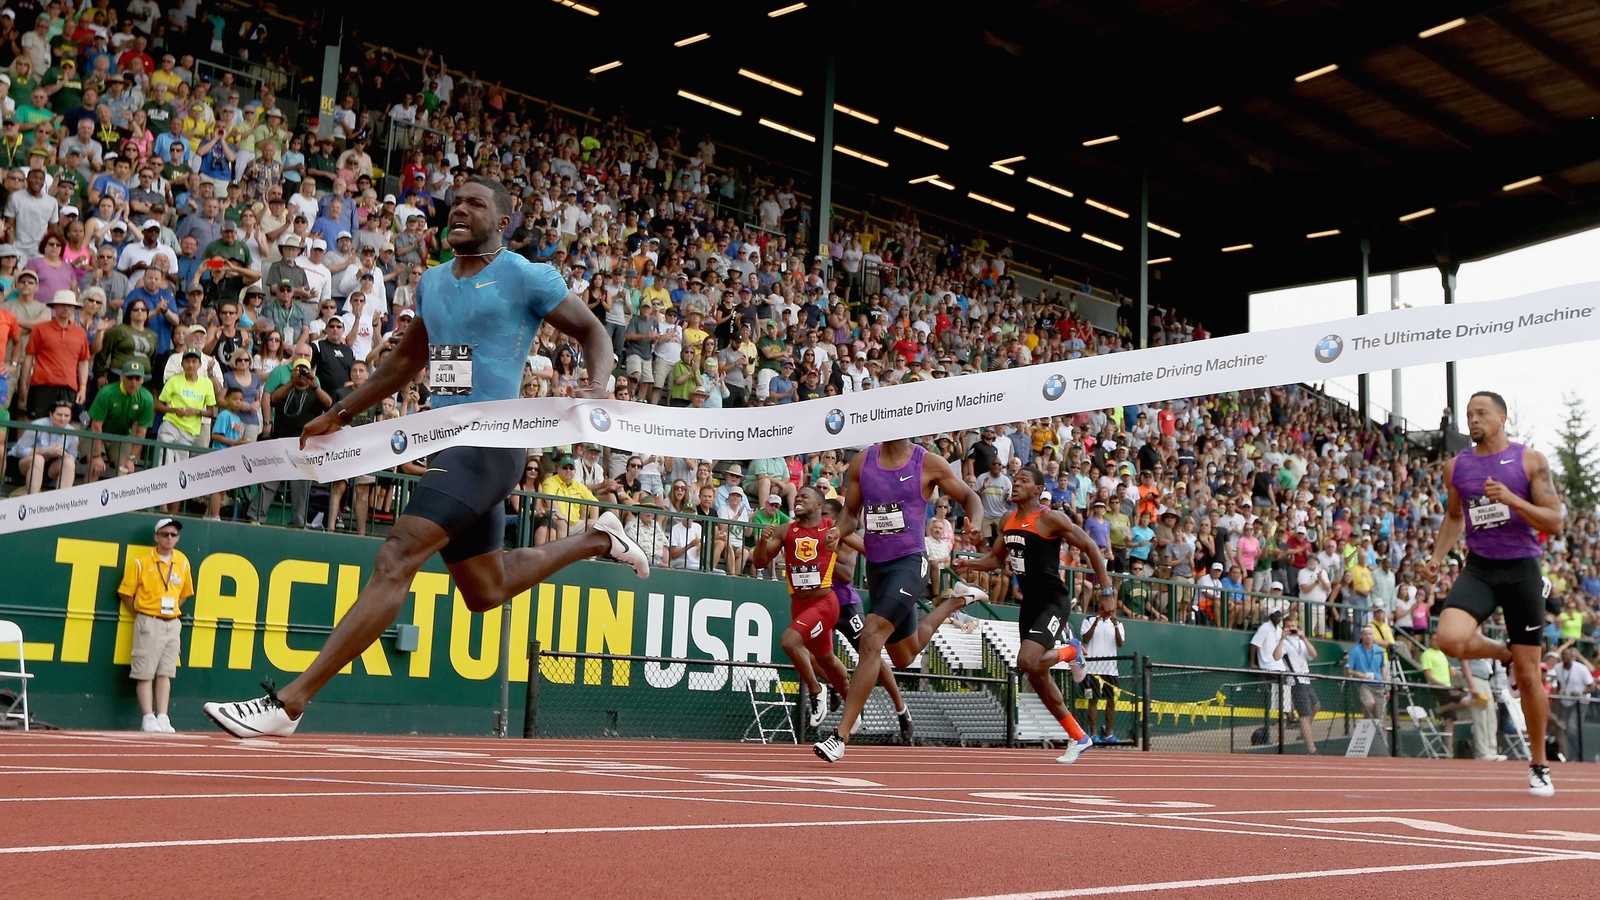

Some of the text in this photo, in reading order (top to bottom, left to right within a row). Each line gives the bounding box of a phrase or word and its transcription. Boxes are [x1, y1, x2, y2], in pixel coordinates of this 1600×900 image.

[321, 95, 335, 111] BC
[1351, 306, 1592, 351] The Ultimate Driving Machine
[1073, 354, 1265, 391] The Ultimate Driving Machine
[850, 391, 1004, 425] The Ultimate Driving Machine
[412, 433, 428, 445] The
[471, 421, 510, 433] Driving
[512, 418, 558, 430] Machine
[617, 418, 793, 441] The Ultimate Driving Machine
[325, 447, 361, 462] Machine
[110, 481, 168, 500] The Ultimate Driving Machine
[29, 498, 88, 515] The Ultimate Driving Machine
[852, 617, 862, 630] 8
[1051, 619, 1059, 633] 6
[644, 593, 779, 692] USA
